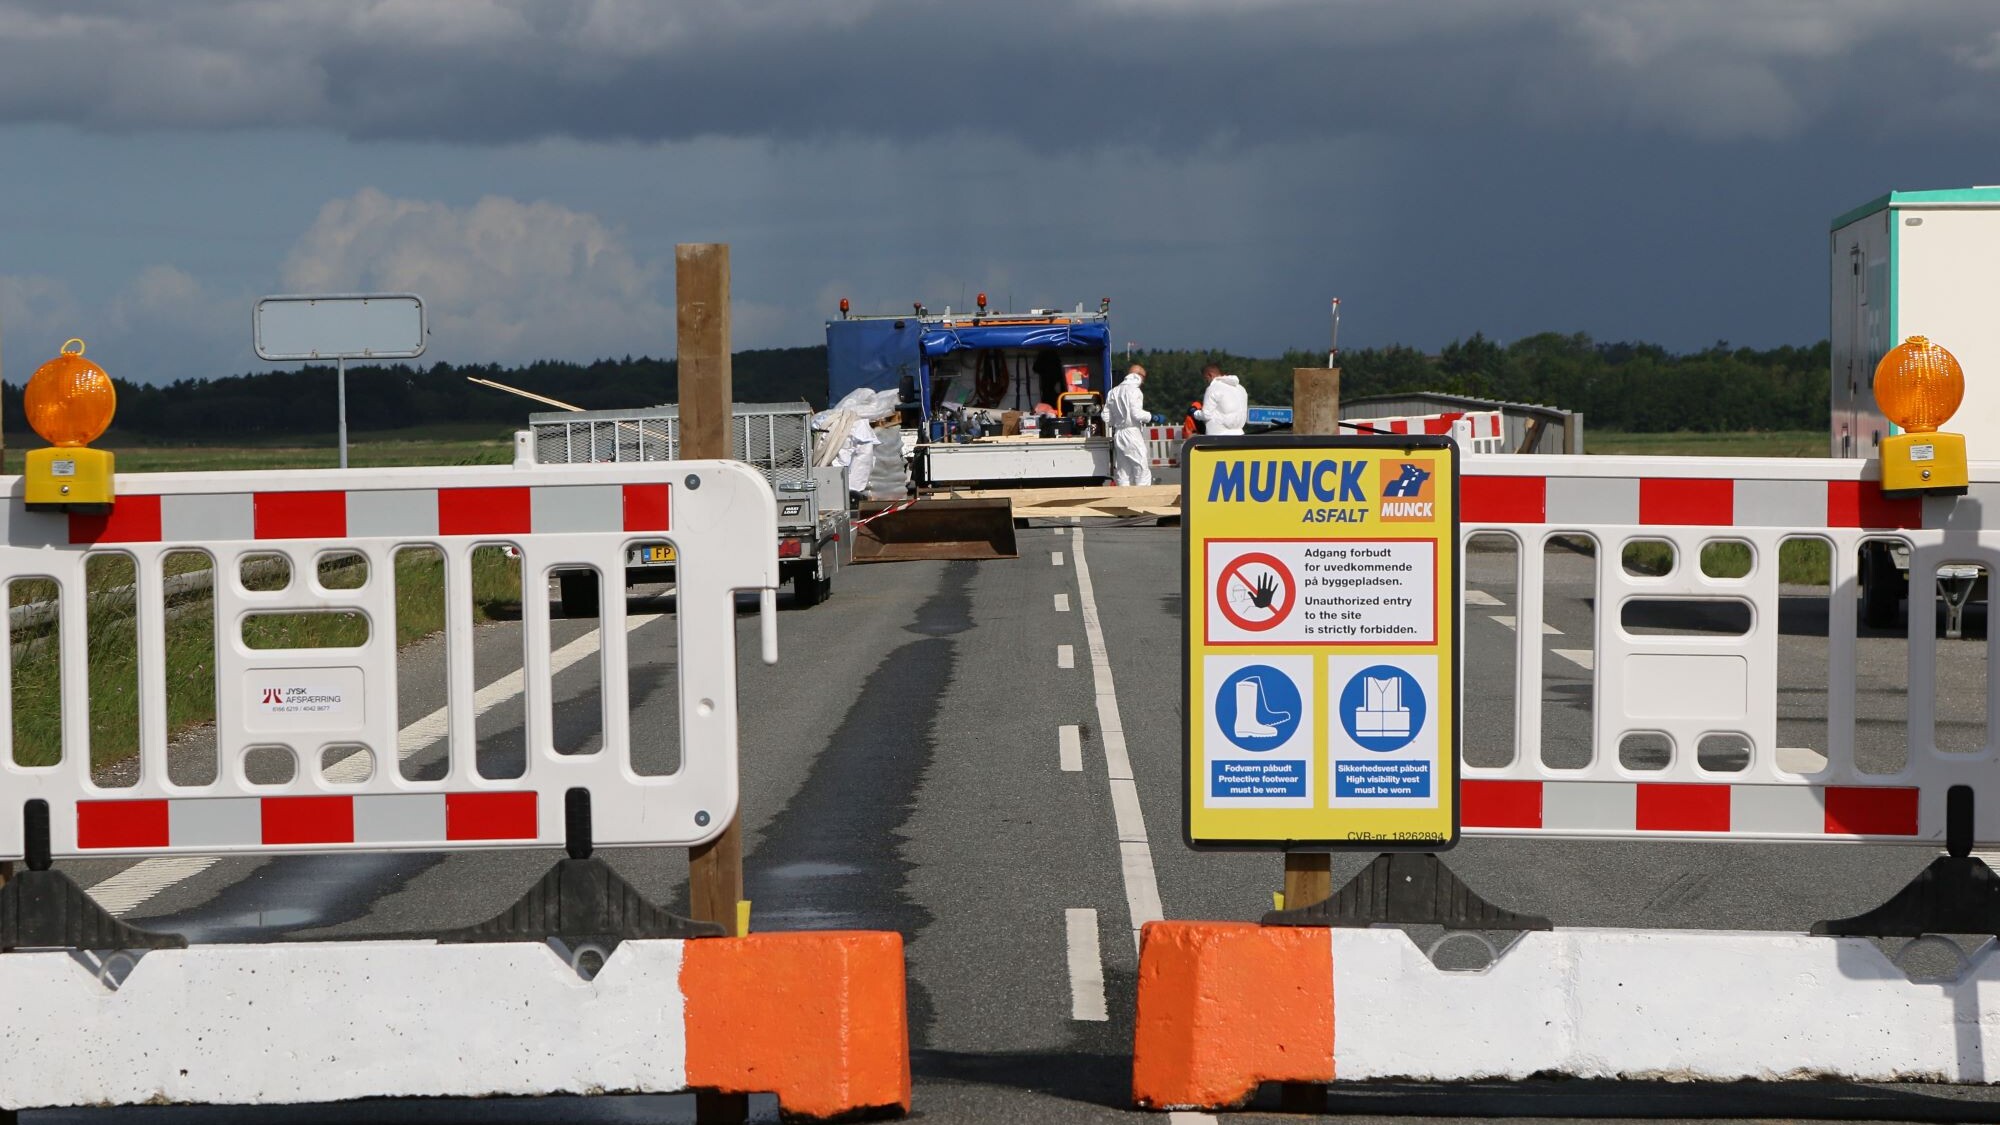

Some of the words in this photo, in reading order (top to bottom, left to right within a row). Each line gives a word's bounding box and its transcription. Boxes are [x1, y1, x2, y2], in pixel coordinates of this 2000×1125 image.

[1207, 460, 1368, 502] MUNCK
[1381, 502, 1433, 517] MUNCK
[1302, 508, 1369, 523] ASFALT
[656, 547, 671, 558] FP
[1304, 548, 1347, 559] Adgang
[1350, 548, 1392, 558] forbudt
[1304, 563, 1320, 572] for
[1323, 563, 1413, 572] uvedkommende
[1304, 576, 1319, 588] på
[1322, 577, 1403, 588] byggepladsen.
[1304, 596, 1380, 606] Unauthorized
[1383, 597, 1412, 607] entry
[1304, 611, 1316, 620] to
[1319, 611, 1338, 620] the
[1341, 611, 1362, 620] site
[1304, 625, 1314, 634] is
[1317, 625, 1357, 636] strictly
[1360, 625, 1417, 634] forbidden.
[1225, 764, 1260, 772] Fodværn
[1263, 764, 1292, 774] påbudt
[1338, 764, 1398, 773] Sikkerhedsvest
[1400, 764, 1428, 774] påbudt
[1218, 775, 1260, 783] Protective
[1262, 775, 1299, 783] footwear
[1346, 775, 1365, 784] High
[1367, 775, 1400, 785] visibility
[1402, 775, 1420, 783] vest
[1230, 786, 1251, 794] must
[1253, 786, 1264, 794] be
[1354, 786, 1376, 794] must
[1378, 786, 1388, 794] be
[1393, 831, 1444, 840] 18262894
